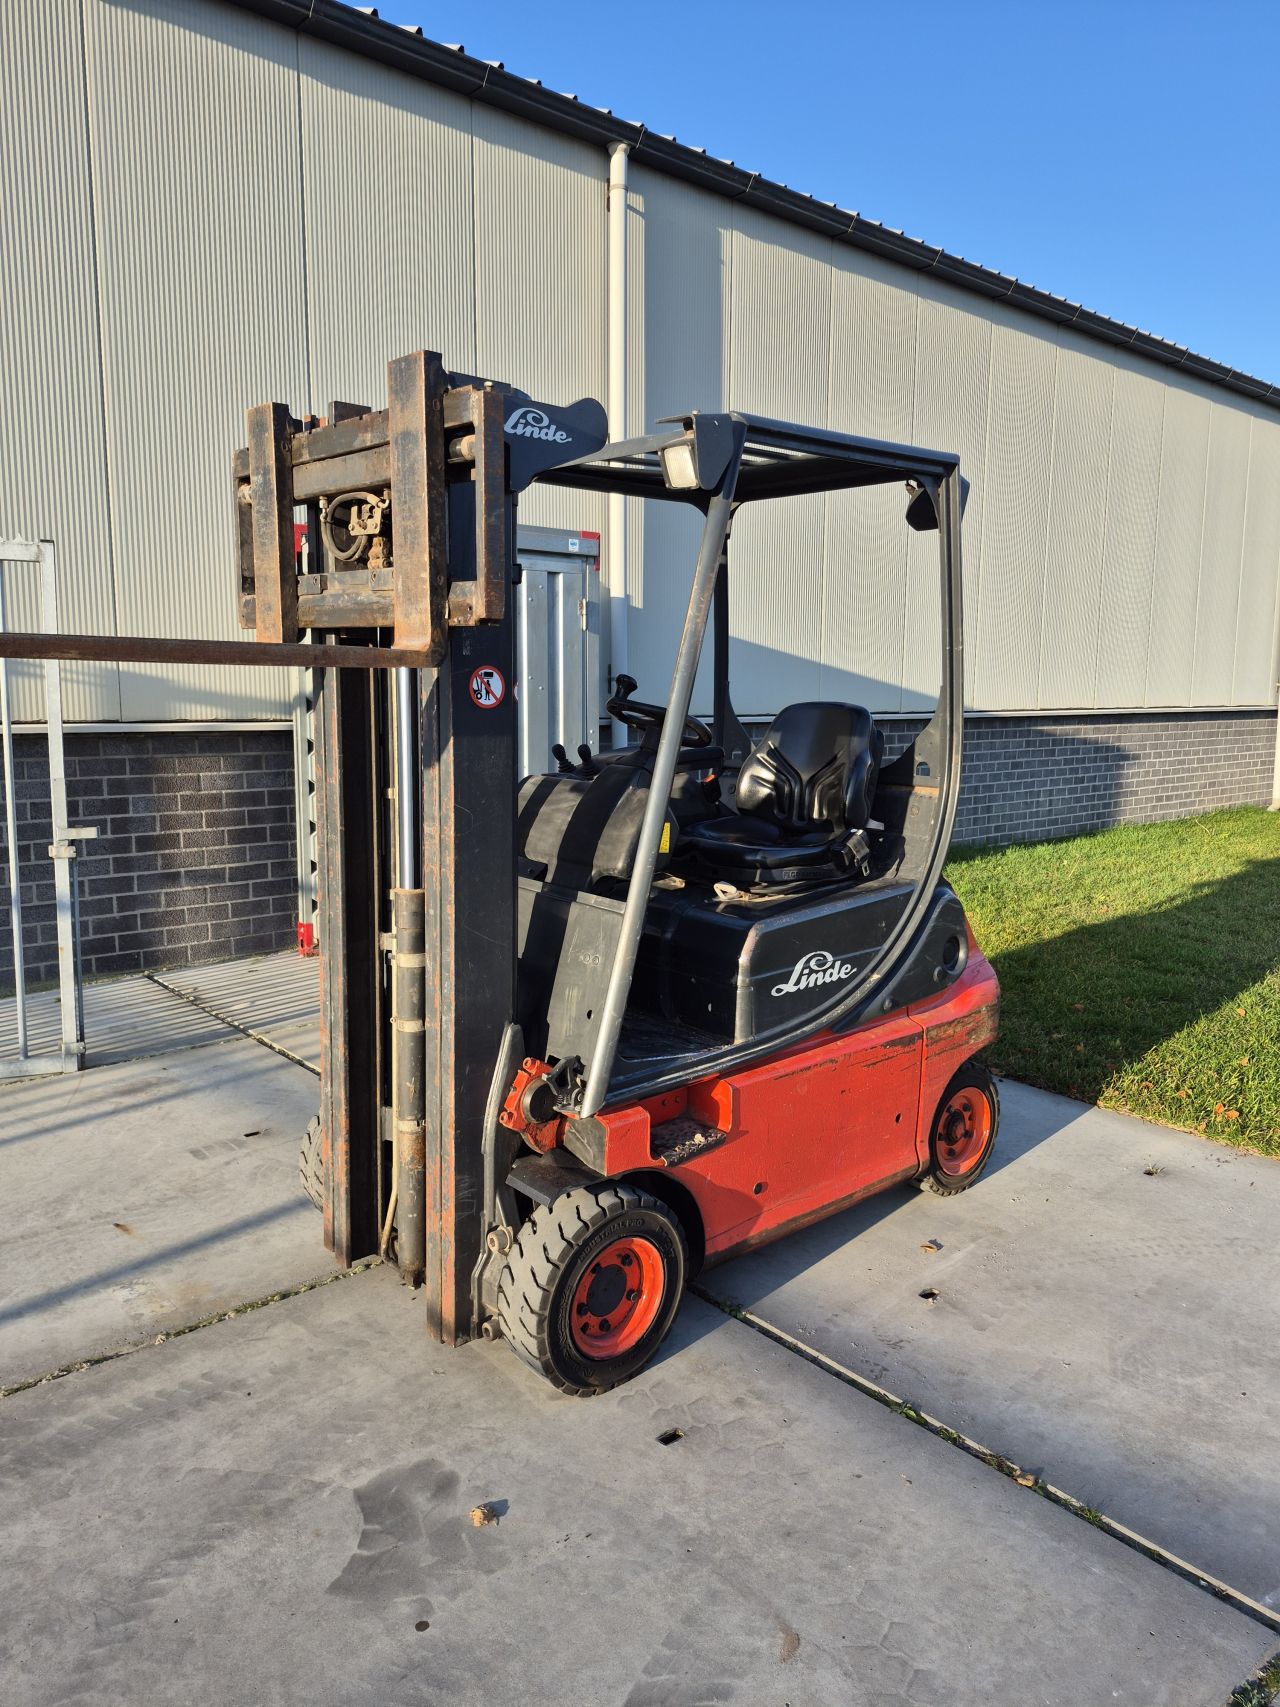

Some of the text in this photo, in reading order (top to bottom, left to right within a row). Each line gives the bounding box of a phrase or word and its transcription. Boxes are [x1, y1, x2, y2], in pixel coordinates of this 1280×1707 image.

[503, 407, 573, 443] Linde
[770, 950, 858, 997] Linde
[577, 1220, 625, 1263] INDUSTRIAL
